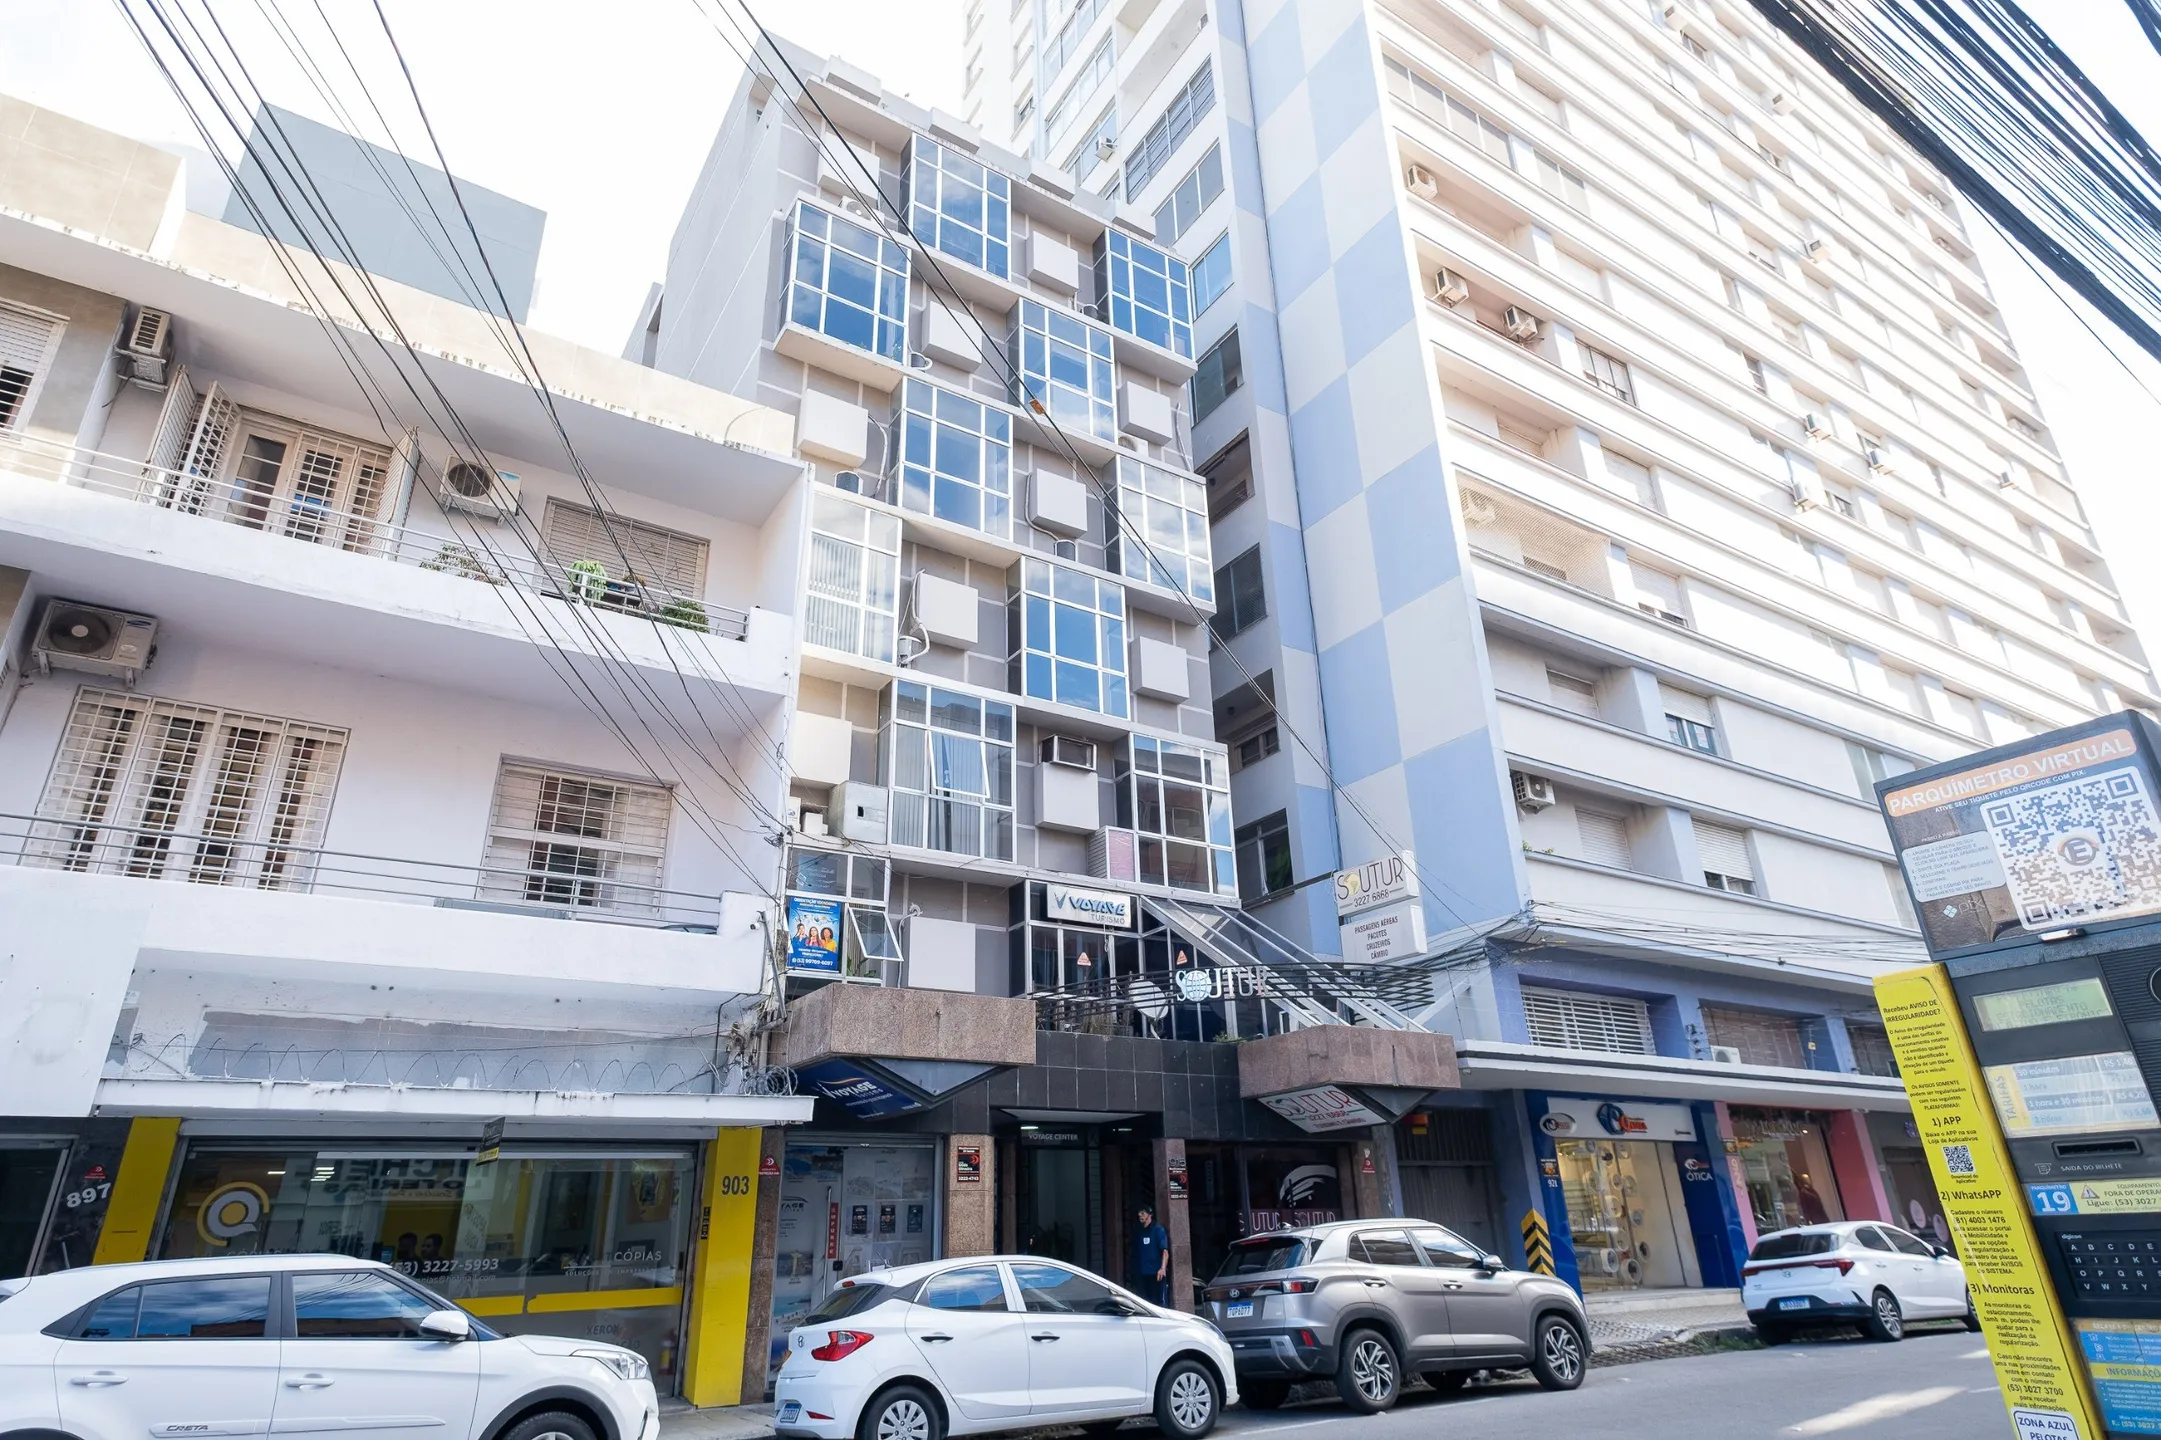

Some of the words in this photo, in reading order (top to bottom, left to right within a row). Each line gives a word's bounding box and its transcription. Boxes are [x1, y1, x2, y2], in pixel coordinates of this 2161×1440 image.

[1890, 763, 2028, 813] PARQUÍMETRO
[2034, 738, 2130, 773] VIRTUAL
[1935, 802, 1954, 813] ATIVE
[1955, 798, 1968, 808] SEU
[2000, 787, 2018, 798] PELO
[2020, 778, 2051, 791] QRCODE
[2053, 773, 2068, 783] COM
[1337, 857, 1403, 900] SOUTUR
[1069, 897, 1125, 916] VOYAGE
[1354, 895, 1370, 907] 3227
[1091, 914, 1125, 924] TURISMO
[1355, 921, 1380, 934] PASSAGENS
[1381, 916, 1398, 926] AÉREAS
[1368, 929, 1387, 940] PACOTES
[1367, 939, 1391, 950] CRUZEIROS
[1371, 949, 1388, 959] CÂMBIO
[1883, 1005, 1908, 1013] Recebeu
[1910, 1001, 1927, 1009] AVISO
[1886, 1009, 1940, 1022] IRREGULARIDADE?
[2029, 1065, 2060, 1074] minutos
[832, 1081, 877, 1097] VOYAGE
[2029, 1082, 2047, 1090] hora
[1996, 1075, 2018, 1121] TARIFAS
[2128, 1091, 2145, 1099] 4,20
[1266, 1090, 1358, 1116] SOUTUR
[2036, 1099, 2053, 1107] hora
[1932, 1117, 1941, 1127] 1)
[1944, 1116, 1961, 1125] APP
[1687, 1171, 1713, 1181] ÓTICA
[722, 1176, 749, 1195] 903
[1548, 1179, 1558, 1188] 921
[66, 1182, 111, 1208] 897
[1941, 1191, 1950, 1201] 2)
[1952, 1190, 2001, 1200] WhatsAPP
[2037, 1191, 2071, 1212] 19
[2087, 1199, 2113, 1207] Ligue:
[614, 1248, 662, 1262] CÓPIAS
[422, 1258, 499, 1273] 3227-5993
[1971, 1284, 1981, 1295] 3)
[1983, 1284, 2034, 1294] Monitoras
[586, 1324, 620, 1335] XEROX
[2008, 1384, 2022, 1394] (53)
[2024, 1385, 2042, 1393] 3027
[2044, 1387, 2063, 1396] 3700
[2018, 1417, 2045, 1428] ZONA
[2048, 1419, 2073, 1432] AZUL
